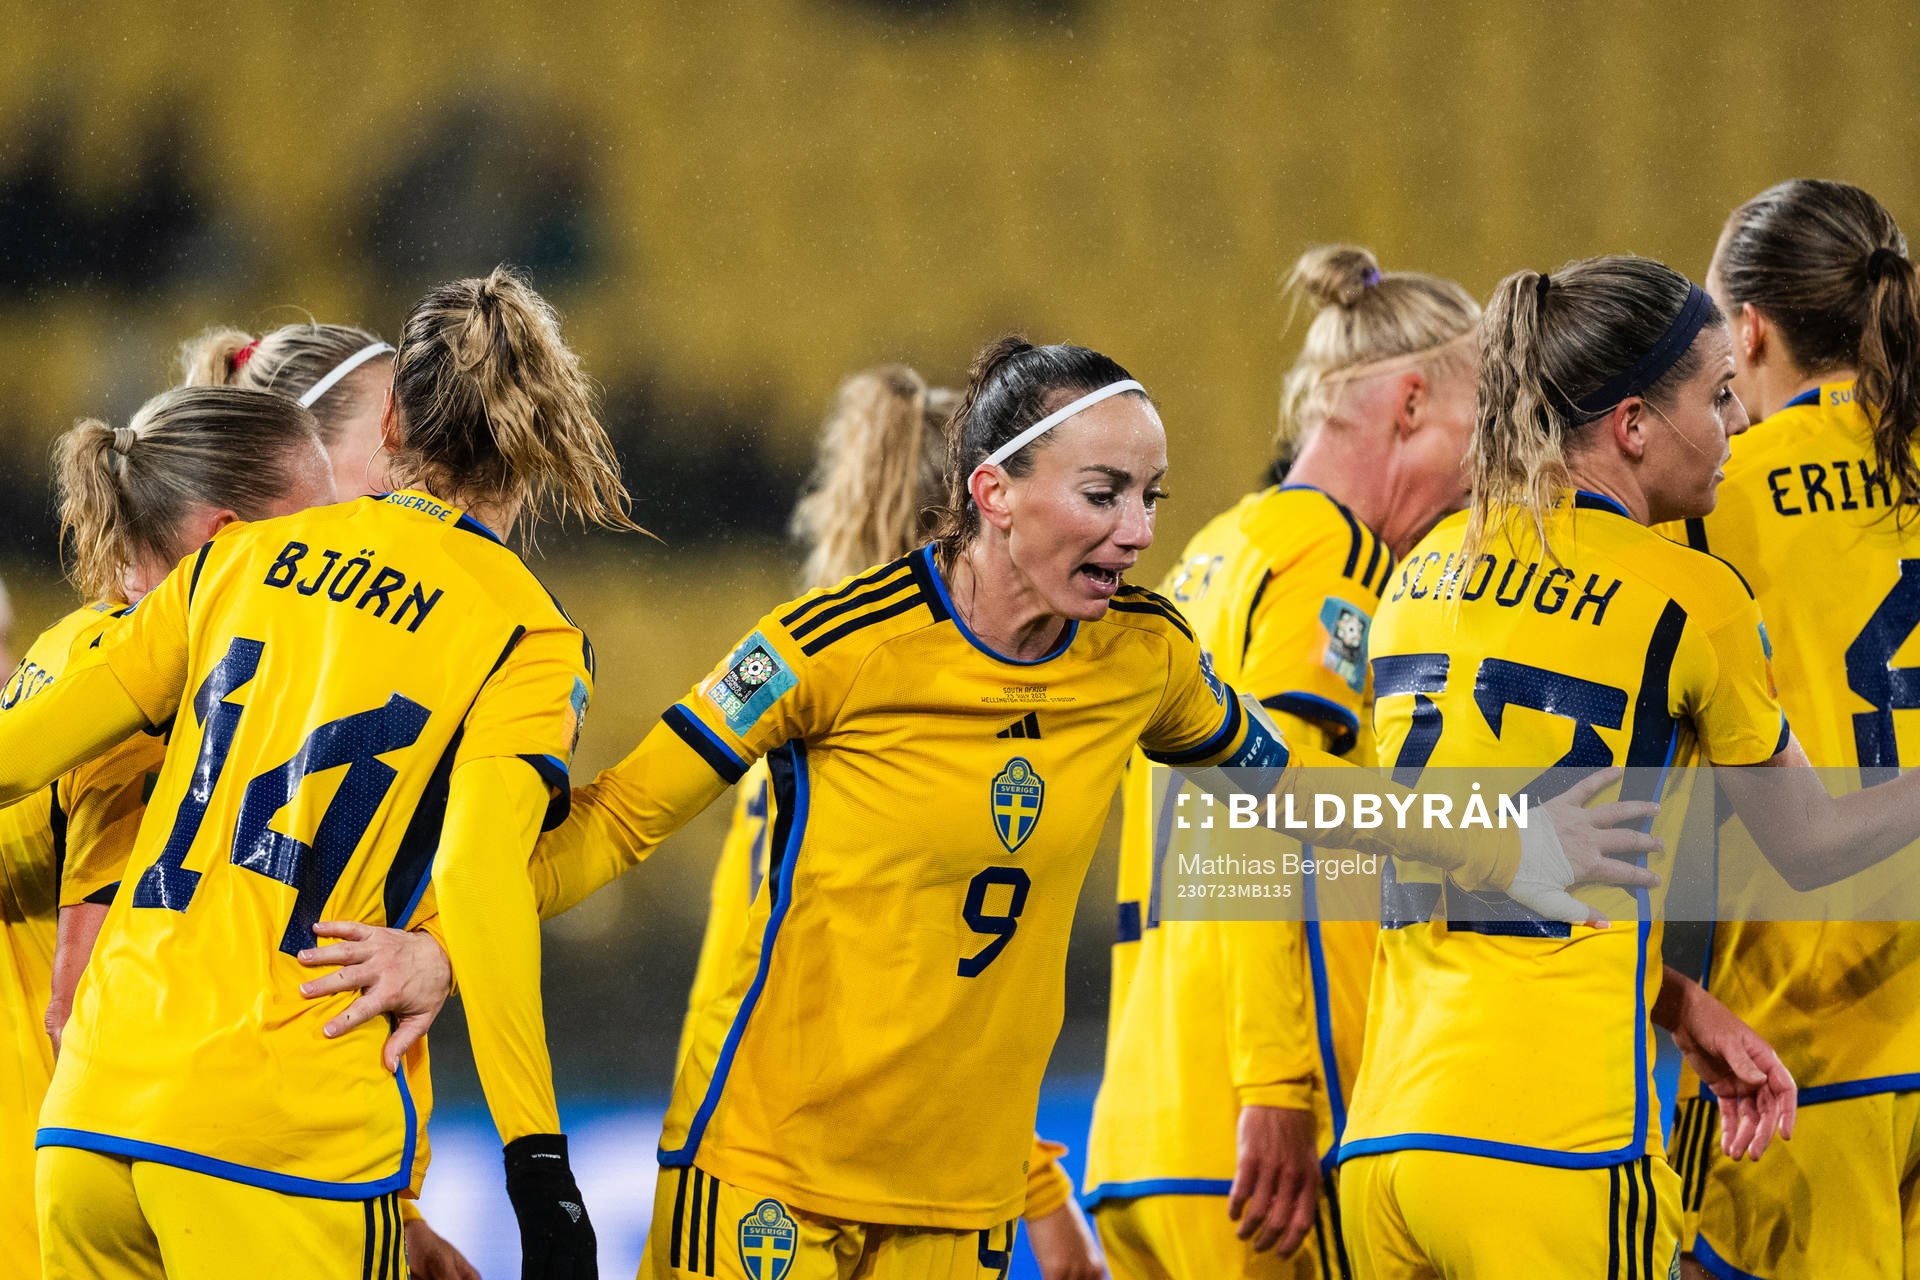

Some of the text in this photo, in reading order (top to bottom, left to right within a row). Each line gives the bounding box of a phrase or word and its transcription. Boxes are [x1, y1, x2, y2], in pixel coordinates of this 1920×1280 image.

[1768, 459, 1920, 516] ERIK
[263, 540, 445, 633] BJÖRN
[1392, 552, 1622, 626] SCHOUGH
[1239, 735, 1263, 768] FIFA
[132, 636, 432, 957] 14
[1000, 785, 1034, 794] SVERIGE
[957, 866, 1032, 978] 9
[749, 1227, 787, 1236] SVERIGE
